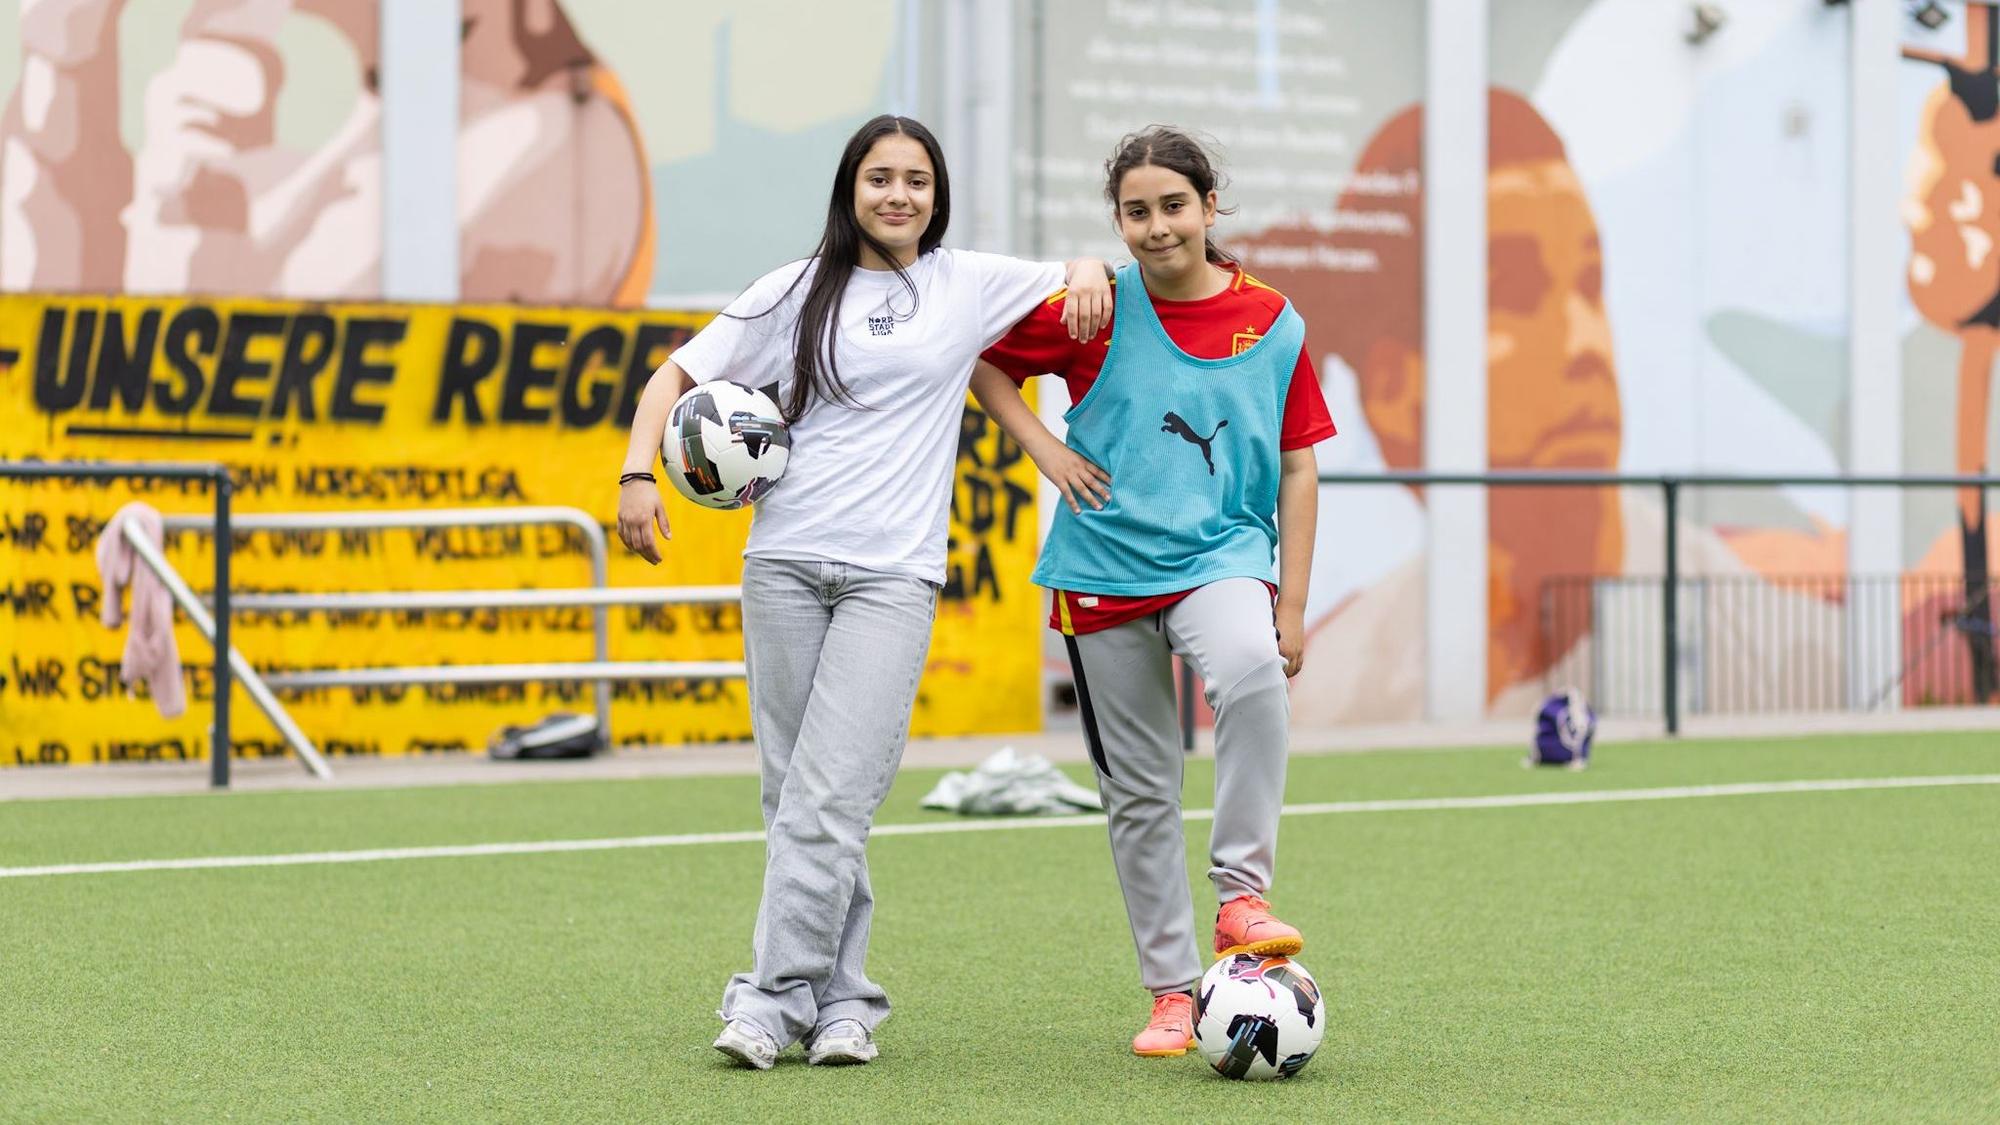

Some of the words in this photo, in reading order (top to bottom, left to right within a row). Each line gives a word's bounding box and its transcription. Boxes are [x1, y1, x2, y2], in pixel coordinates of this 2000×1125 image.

[868, 322, 895, 331] STADT
[34, 305, 409, 425] UNSERE
[12, 653, 68, 702] WIR
